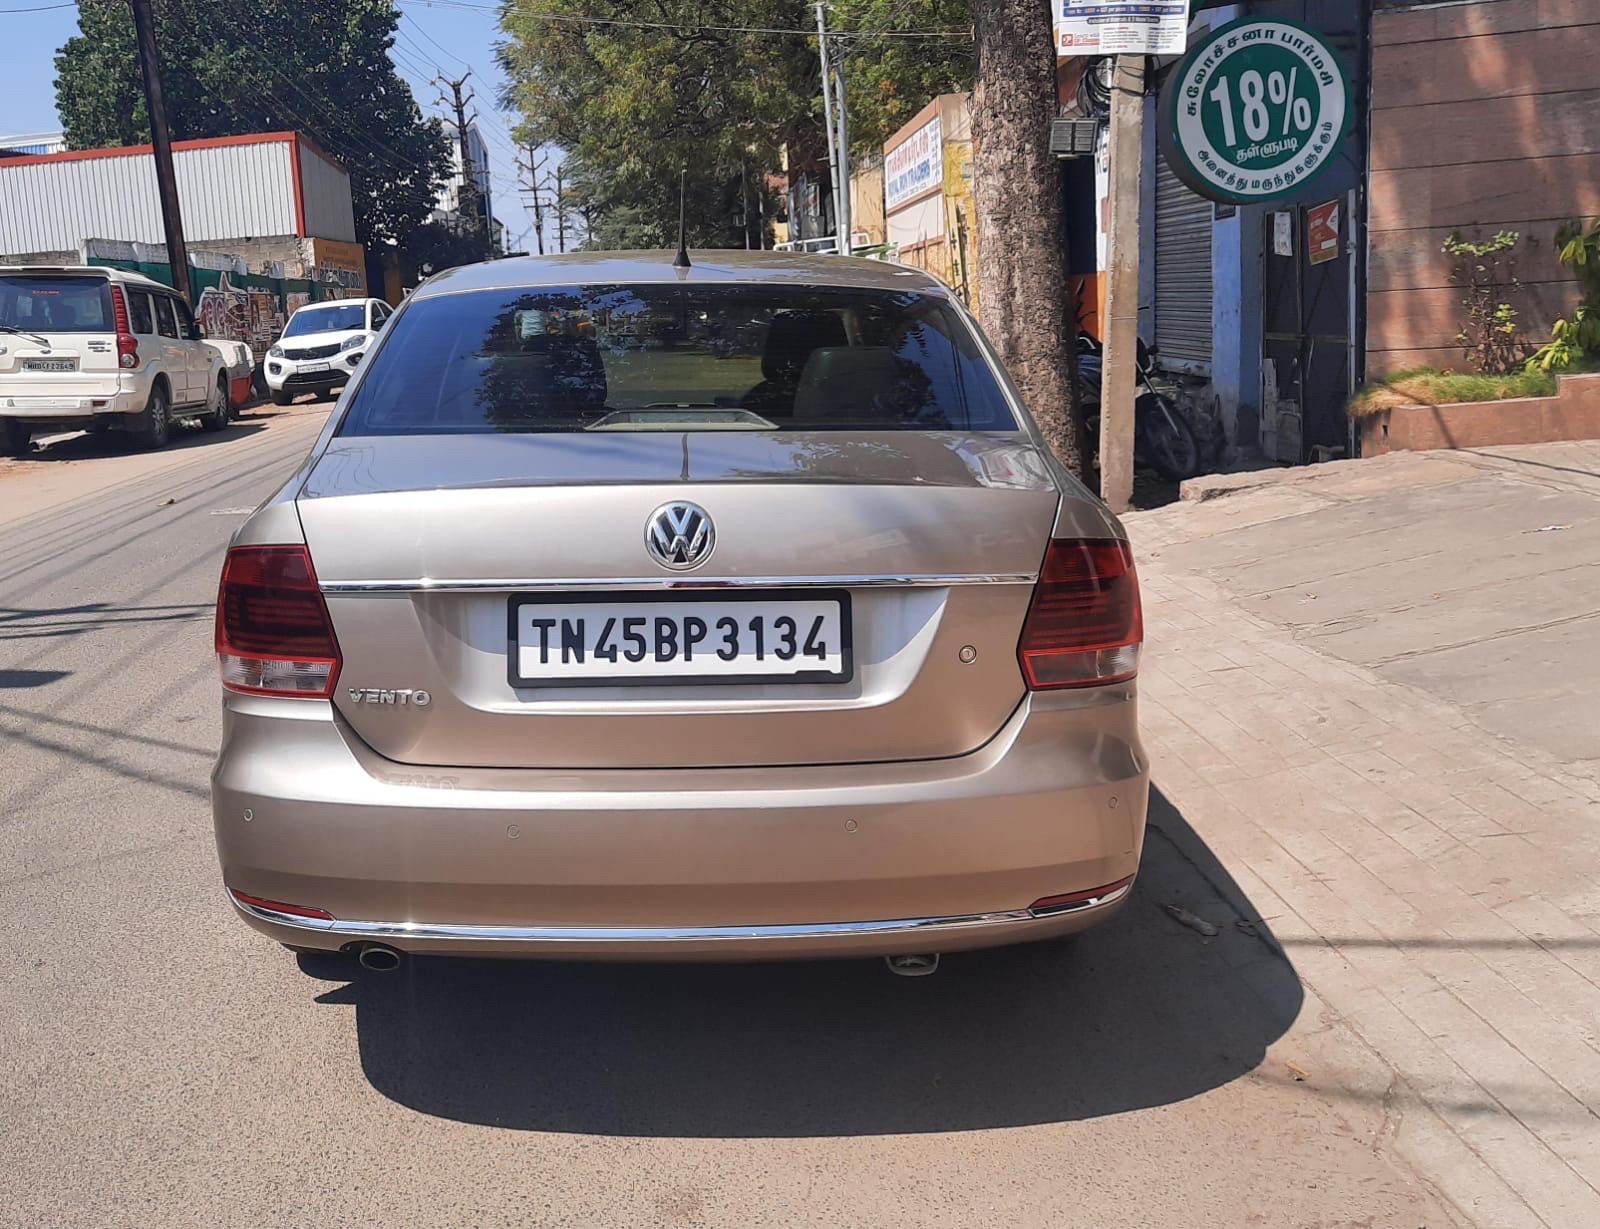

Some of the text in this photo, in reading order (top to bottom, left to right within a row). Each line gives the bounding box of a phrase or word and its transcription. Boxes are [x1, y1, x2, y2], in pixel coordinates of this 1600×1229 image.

[1186, 29, 1334, 117] சுலோச்சனா பார்மசி
[1210, 66, 1312, 147] 18%
[1198, 121, 1333, 191] அனைத்து மருந்துகளுக்கும்
[1236, 136, 1299, 164] தள்ளுபடி
[348, 688, 432, 706] VENTO
